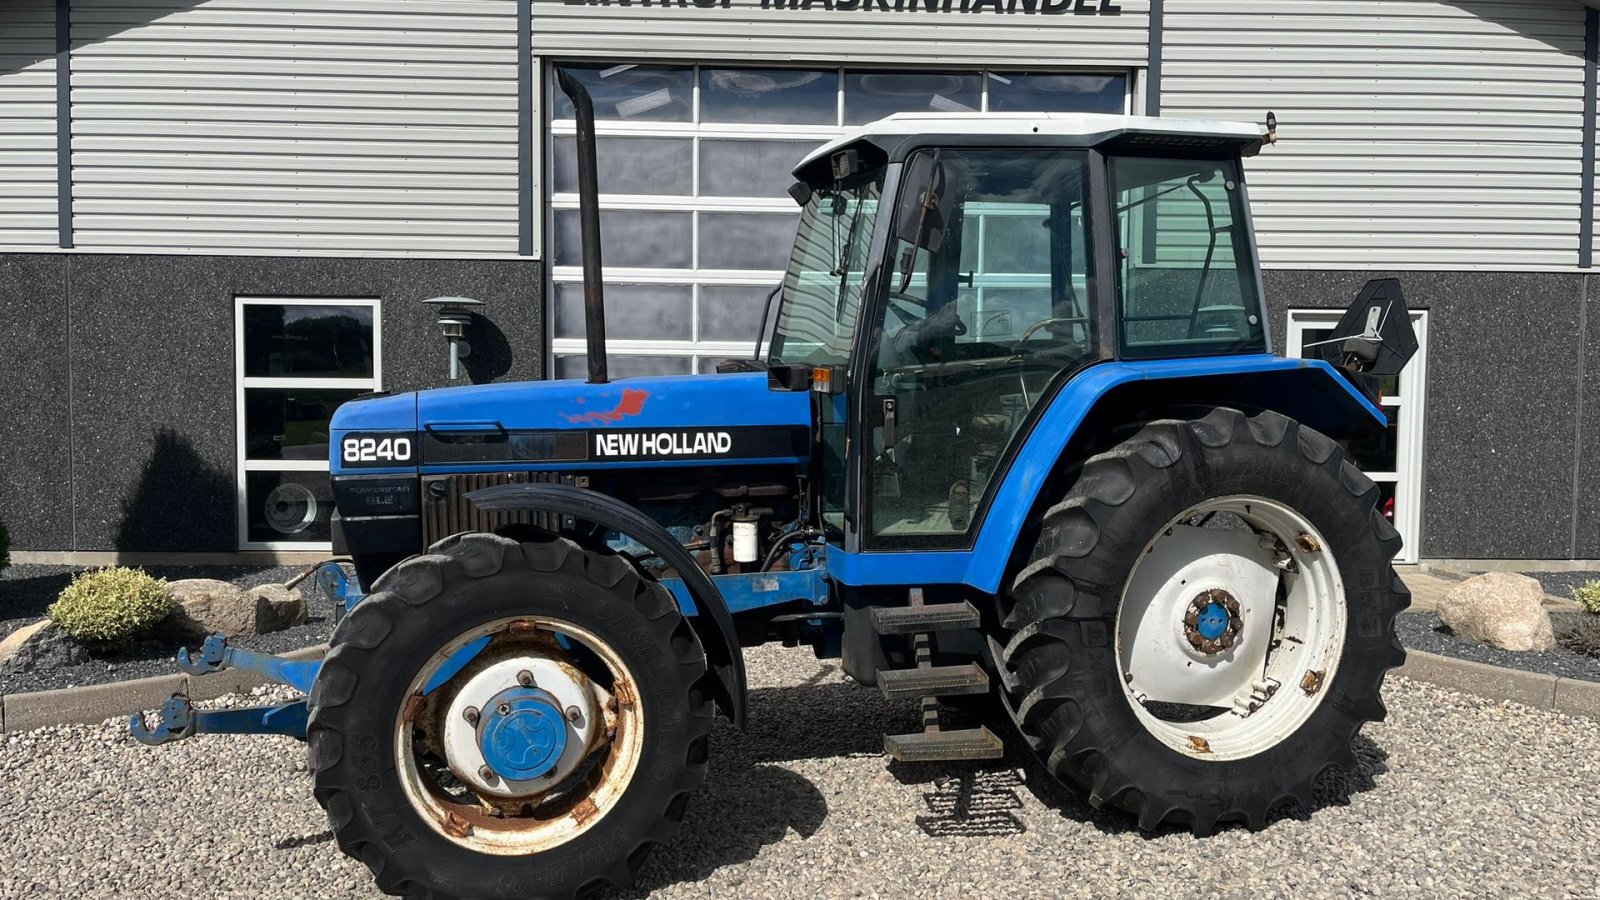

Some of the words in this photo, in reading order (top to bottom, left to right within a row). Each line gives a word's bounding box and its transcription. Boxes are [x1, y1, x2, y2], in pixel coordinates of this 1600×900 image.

[343, 437, 412, 462] 8240
[595, 433, 640, 456] NEW
[642, 431, 732, 455] HOLLAND
